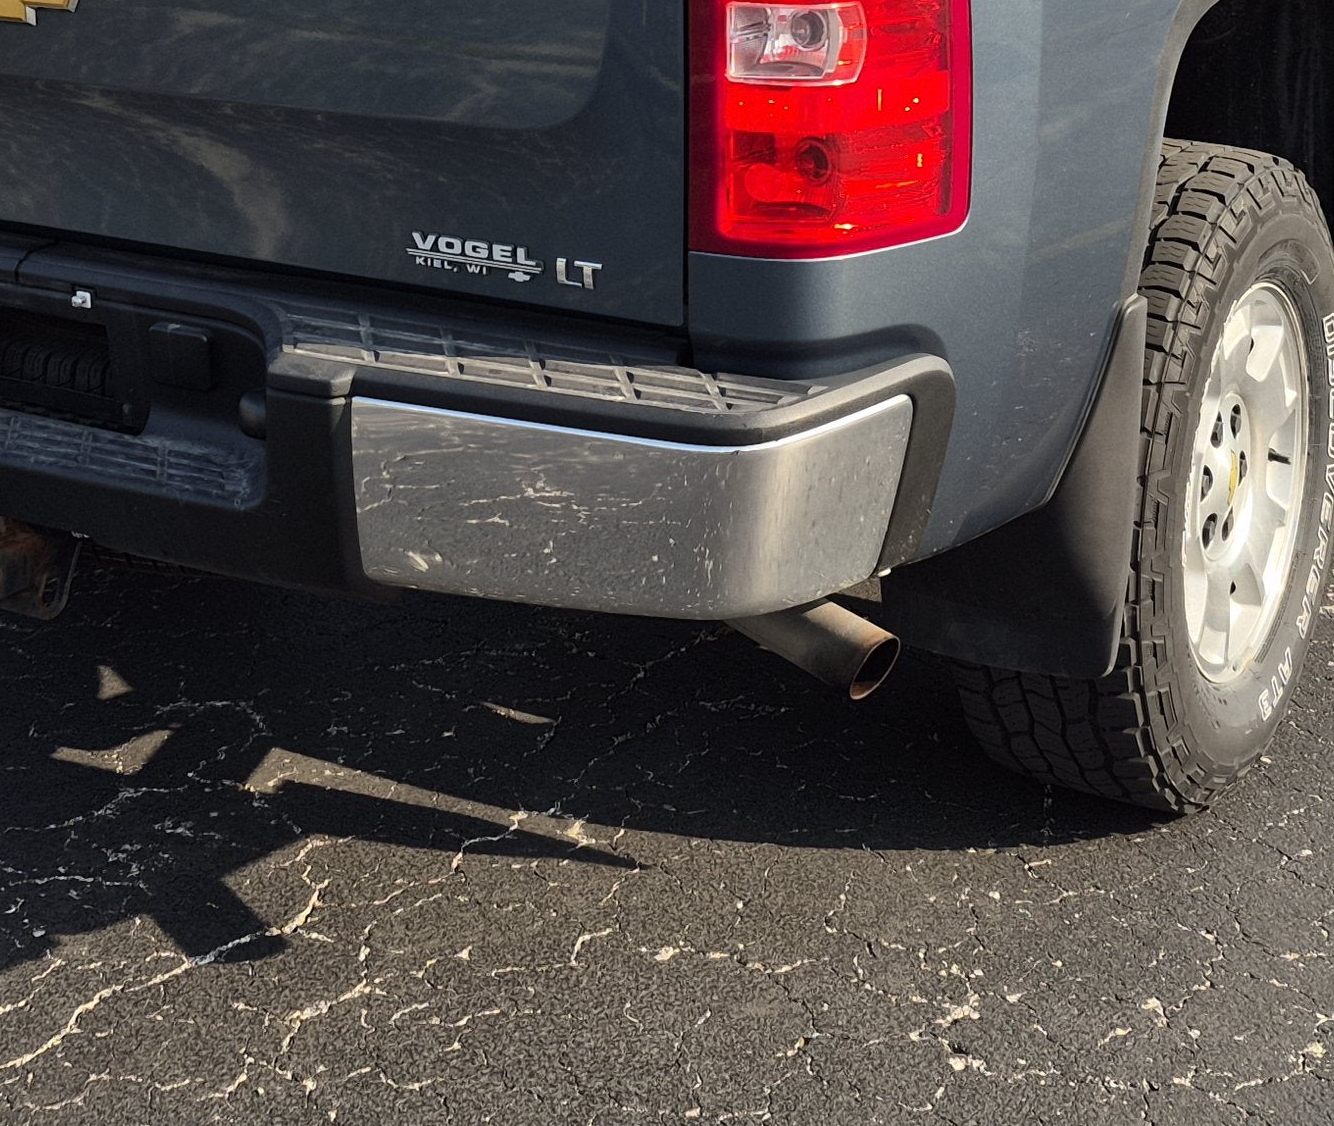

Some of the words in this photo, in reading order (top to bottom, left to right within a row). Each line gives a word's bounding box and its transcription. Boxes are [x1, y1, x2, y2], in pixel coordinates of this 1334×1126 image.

[412, 231, 537, 265] VOGEL
[415, 256, 458, 273] KIEL,
[466, 263, 487, 276] WI
[556, 257, 603, 290] LT
[1258, 646, 1293, 721] AT3
